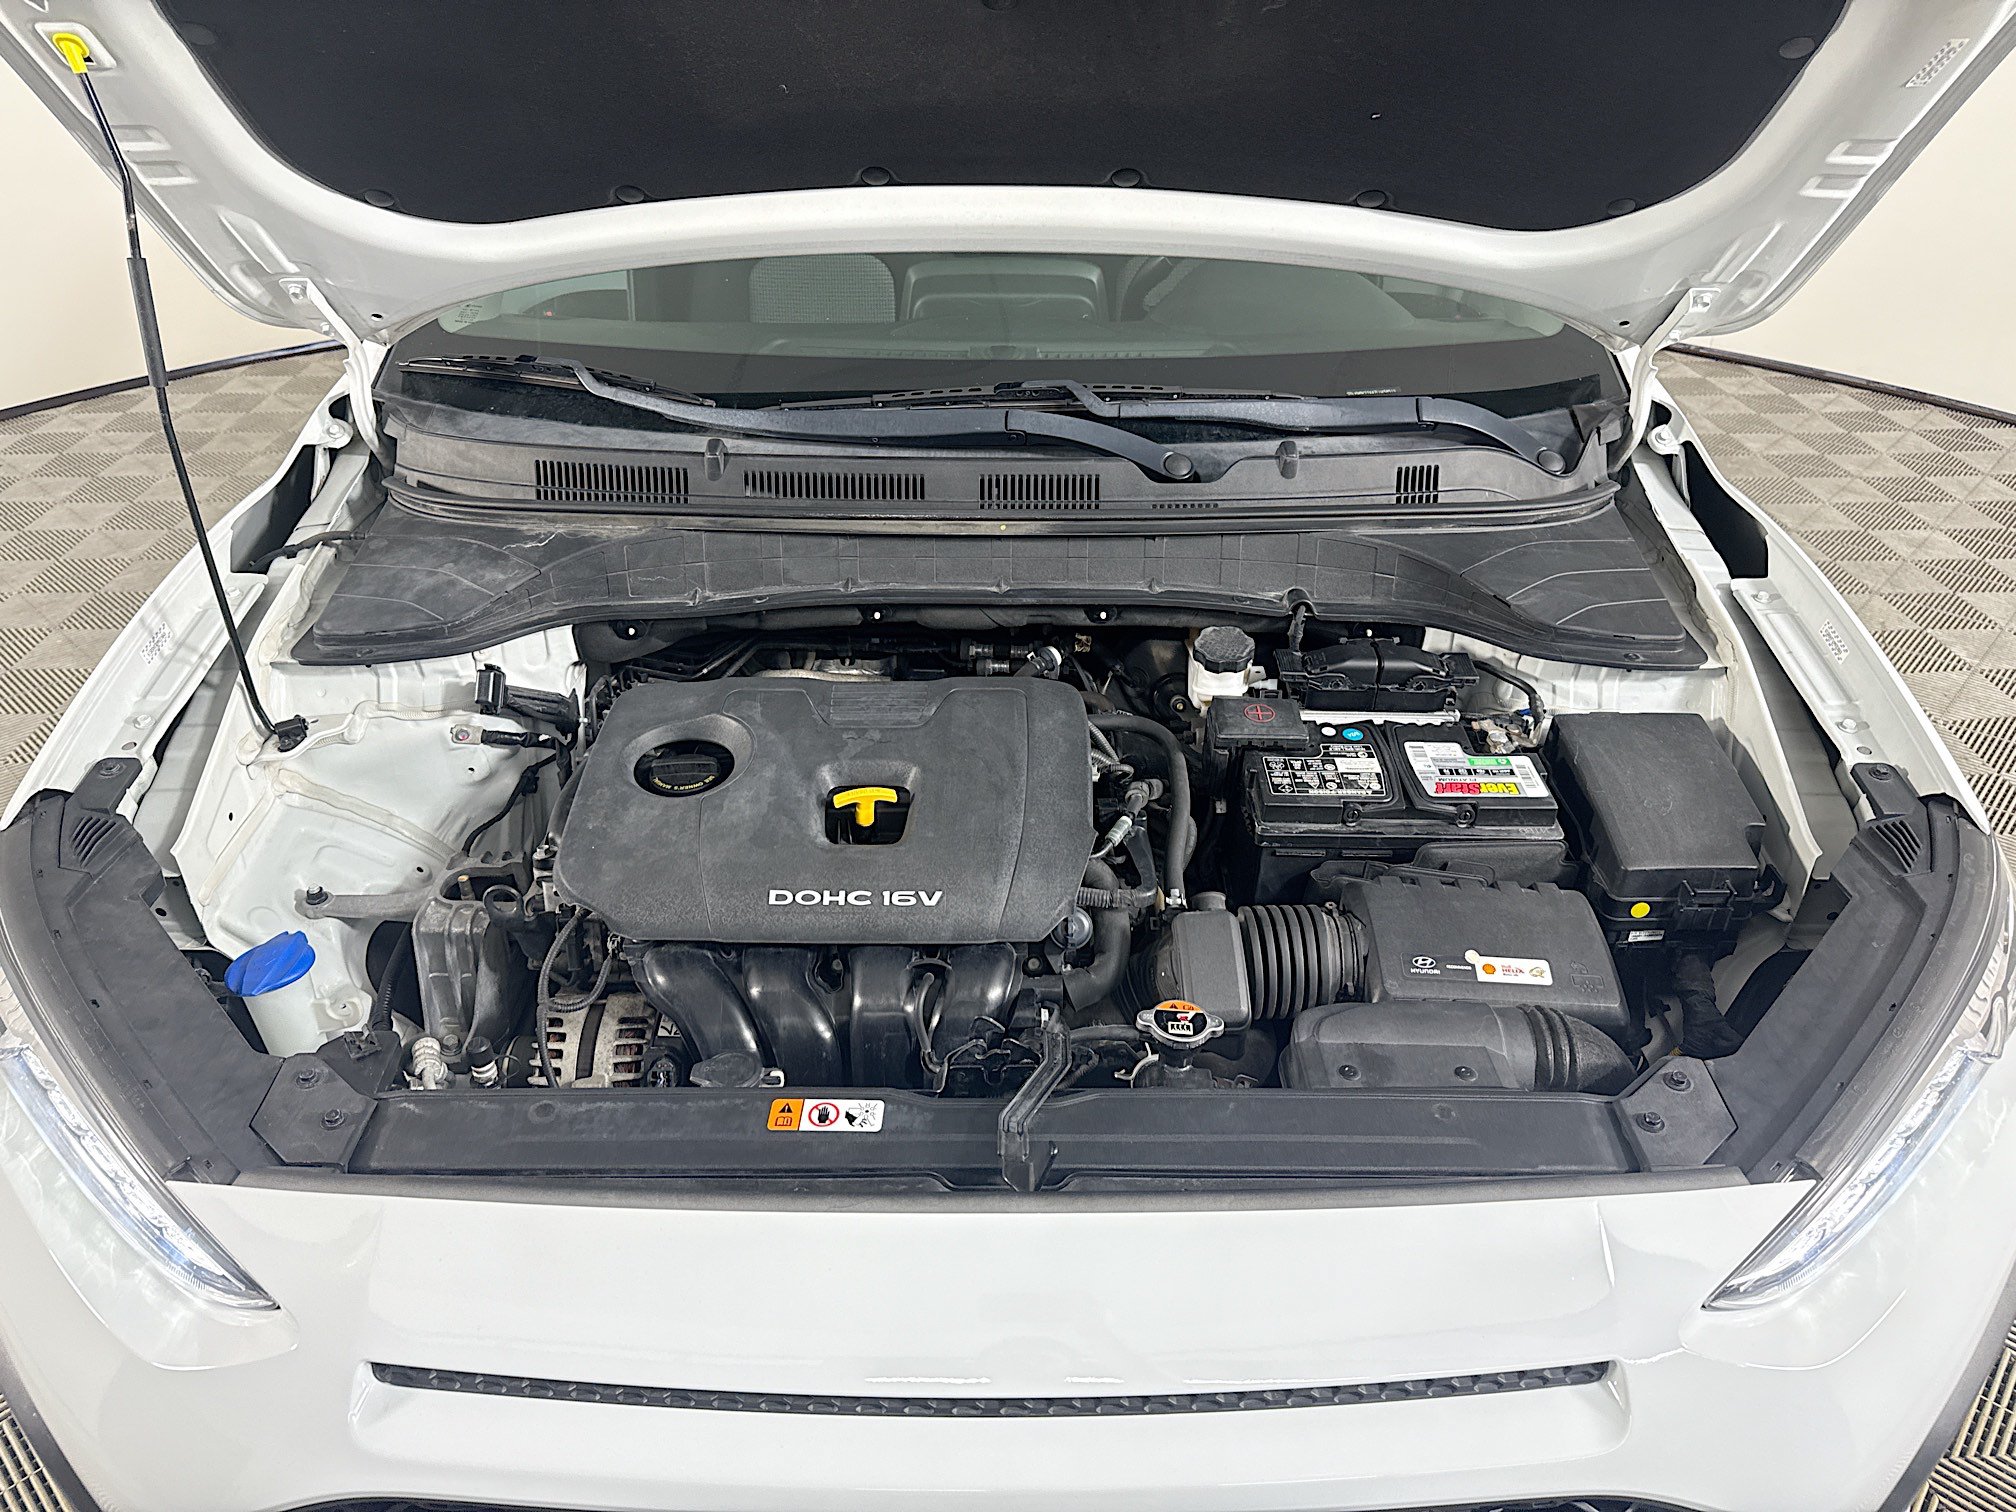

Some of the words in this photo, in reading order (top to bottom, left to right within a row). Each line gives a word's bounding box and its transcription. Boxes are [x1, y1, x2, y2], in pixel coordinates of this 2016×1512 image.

[672, 780, 704, 791] OWNER'S
[1434, 782, 1520, 795] EverStart
[768, 889, 873, 907] DOHC
[882, 890, 943, 907] 16V
[1410, 967, 1441, 975] HYUNDAI
